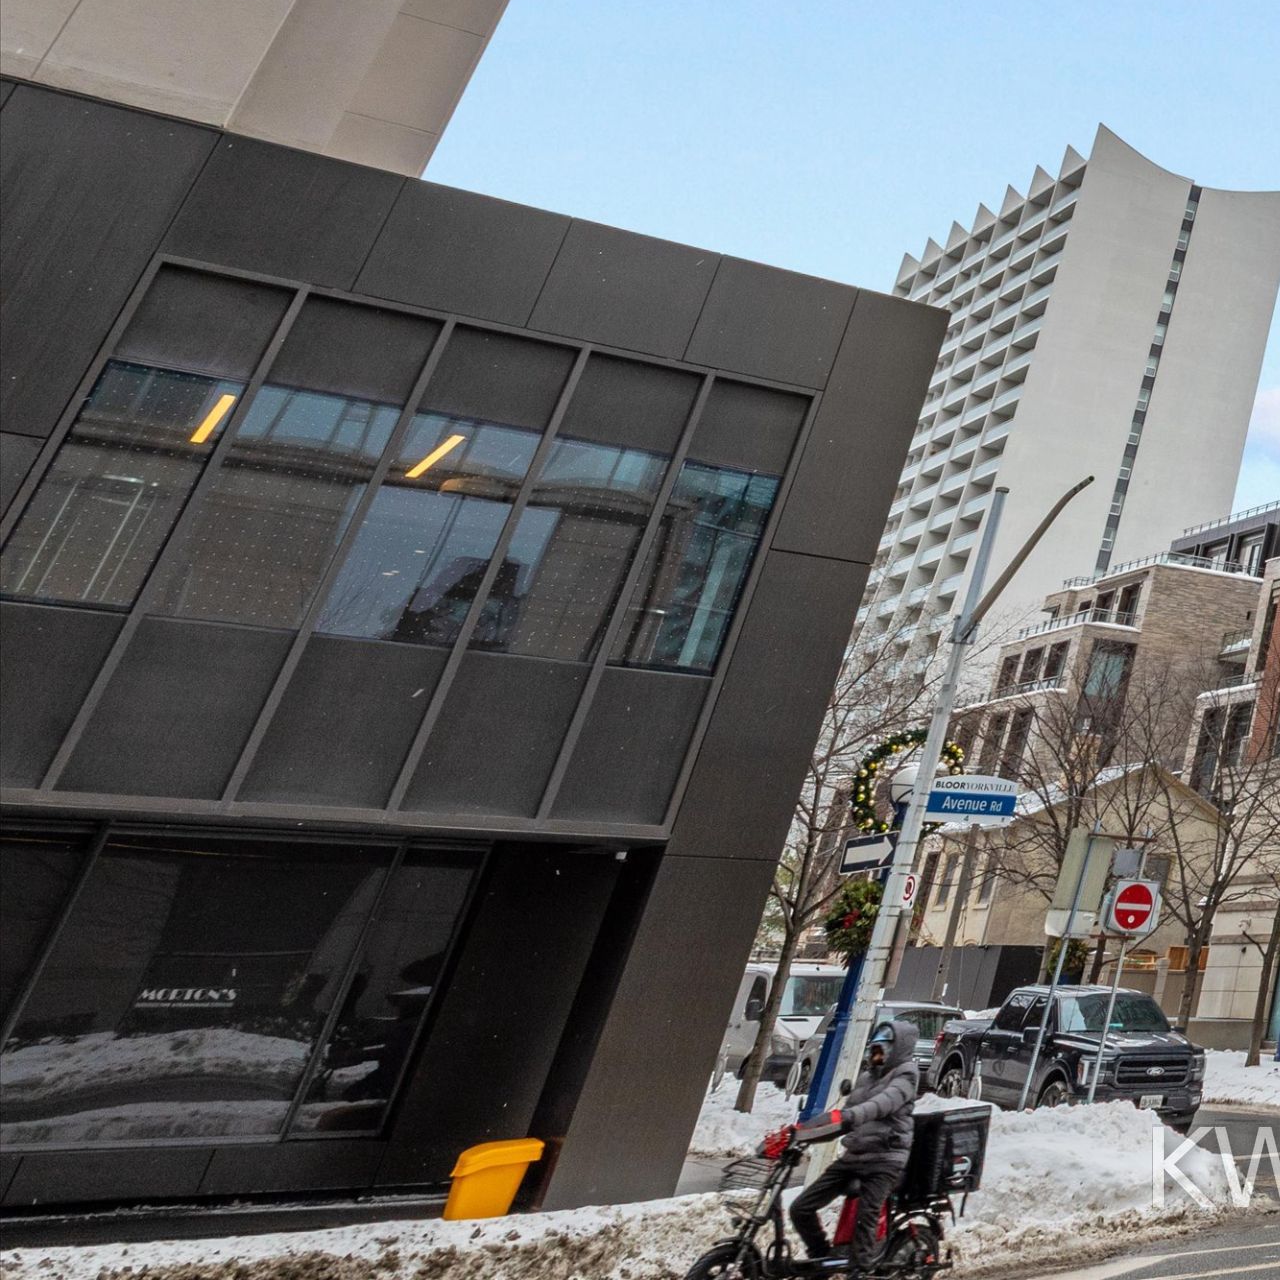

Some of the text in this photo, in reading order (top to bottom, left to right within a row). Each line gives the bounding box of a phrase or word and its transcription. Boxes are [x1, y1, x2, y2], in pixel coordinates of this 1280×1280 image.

[942, 795, 1003, 812] Avenue Rd
[137, 988, 239, 1001] MORTON'S
